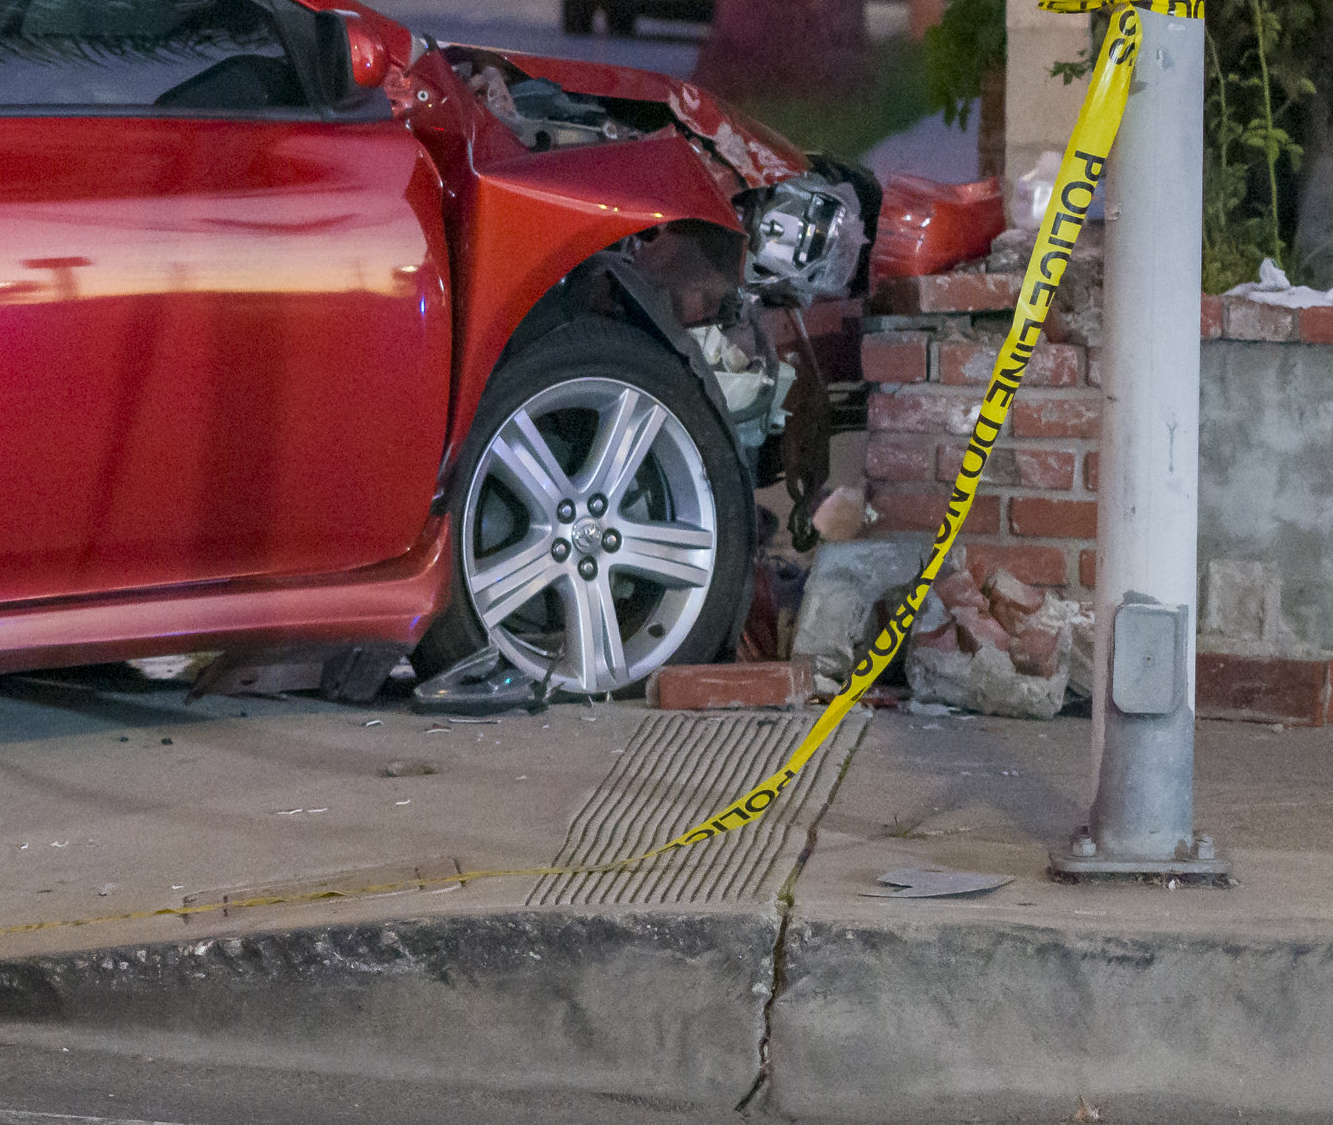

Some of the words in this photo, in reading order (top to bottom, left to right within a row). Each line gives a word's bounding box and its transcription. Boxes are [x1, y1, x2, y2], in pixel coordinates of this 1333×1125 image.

[1029, 150, 1106, 308] POLICE
[986, 321, 1042, 409] LINE
[960, 412, 1004, 479] DO
